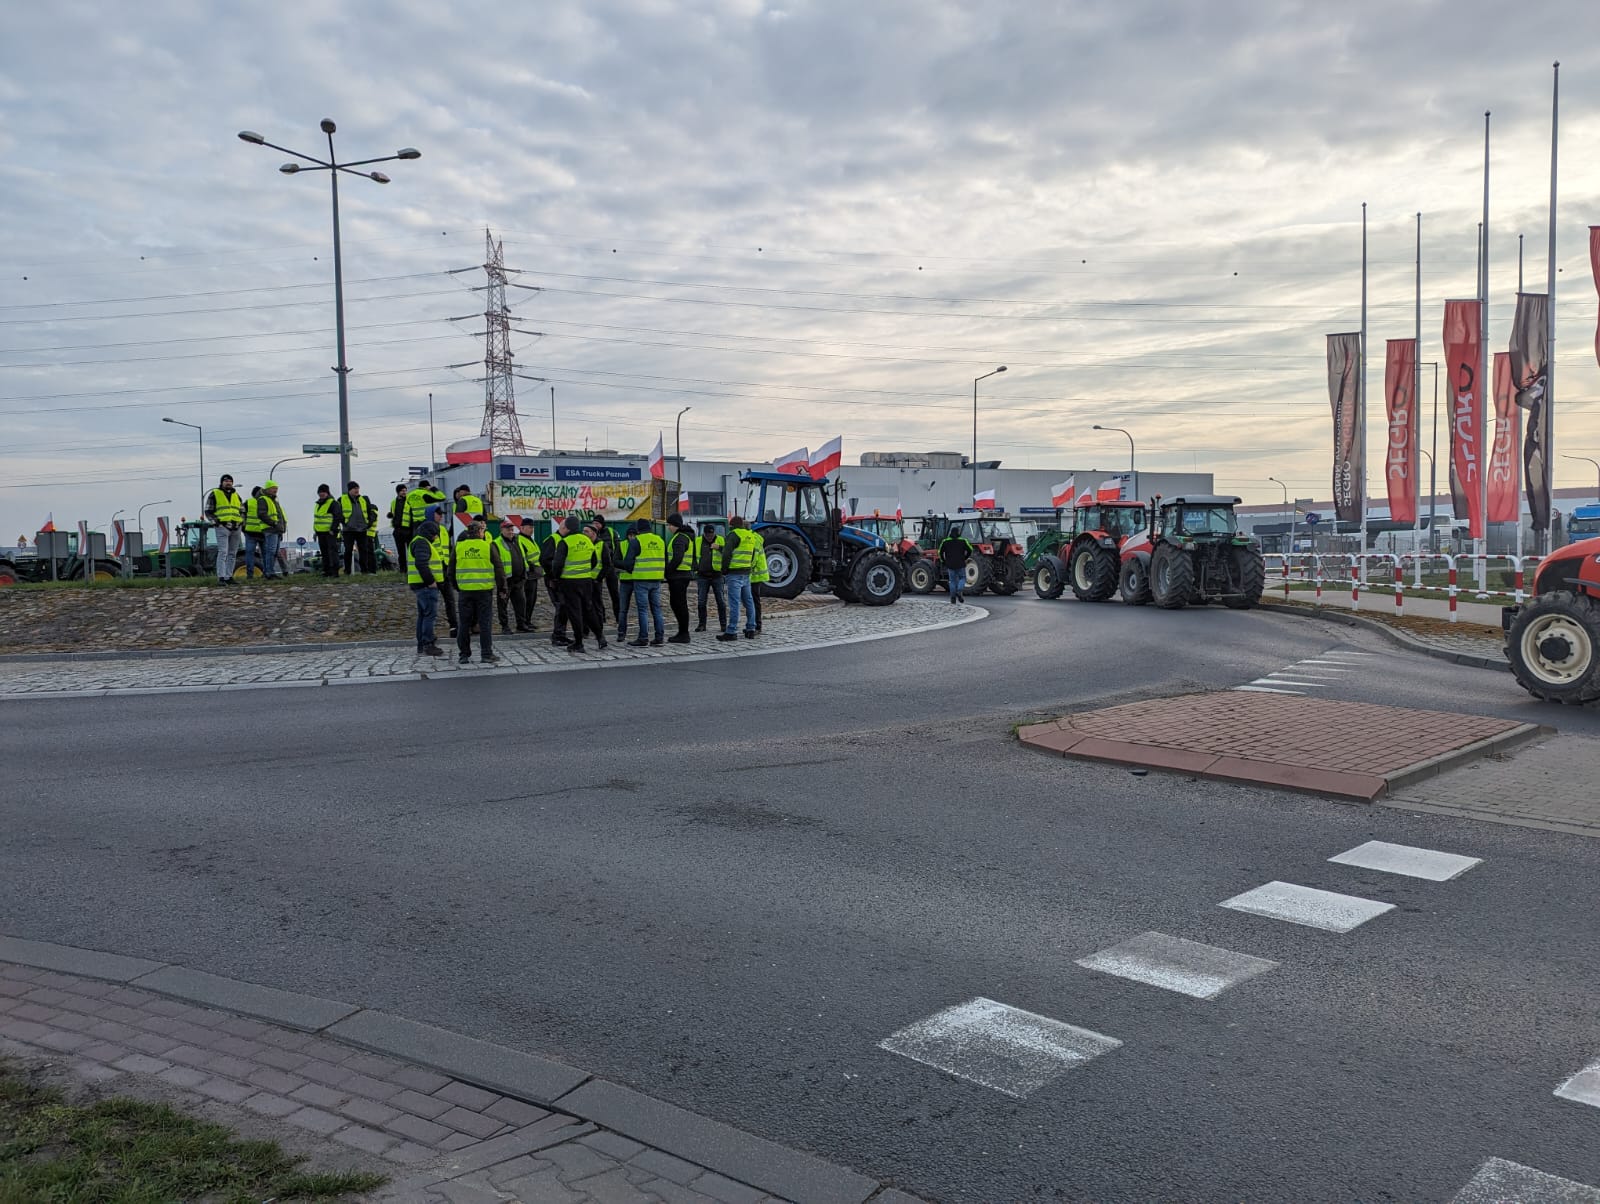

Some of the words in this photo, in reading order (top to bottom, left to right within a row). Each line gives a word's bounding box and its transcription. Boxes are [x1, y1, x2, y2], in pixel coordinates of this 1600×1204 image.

[565, 469, 580, 477] ESA
[582, 470, 604, 478] Trucks
[605, 470, 630, 478] Poznań
[501, 485, 578, 498] PRZEPRASZAMY
[579, 485, 592, 498] ZA
[509, 498, 536, 510] MAMY
[538, 498, 576, 510] ZIELONY
[618, 497, 635, 509] DO
